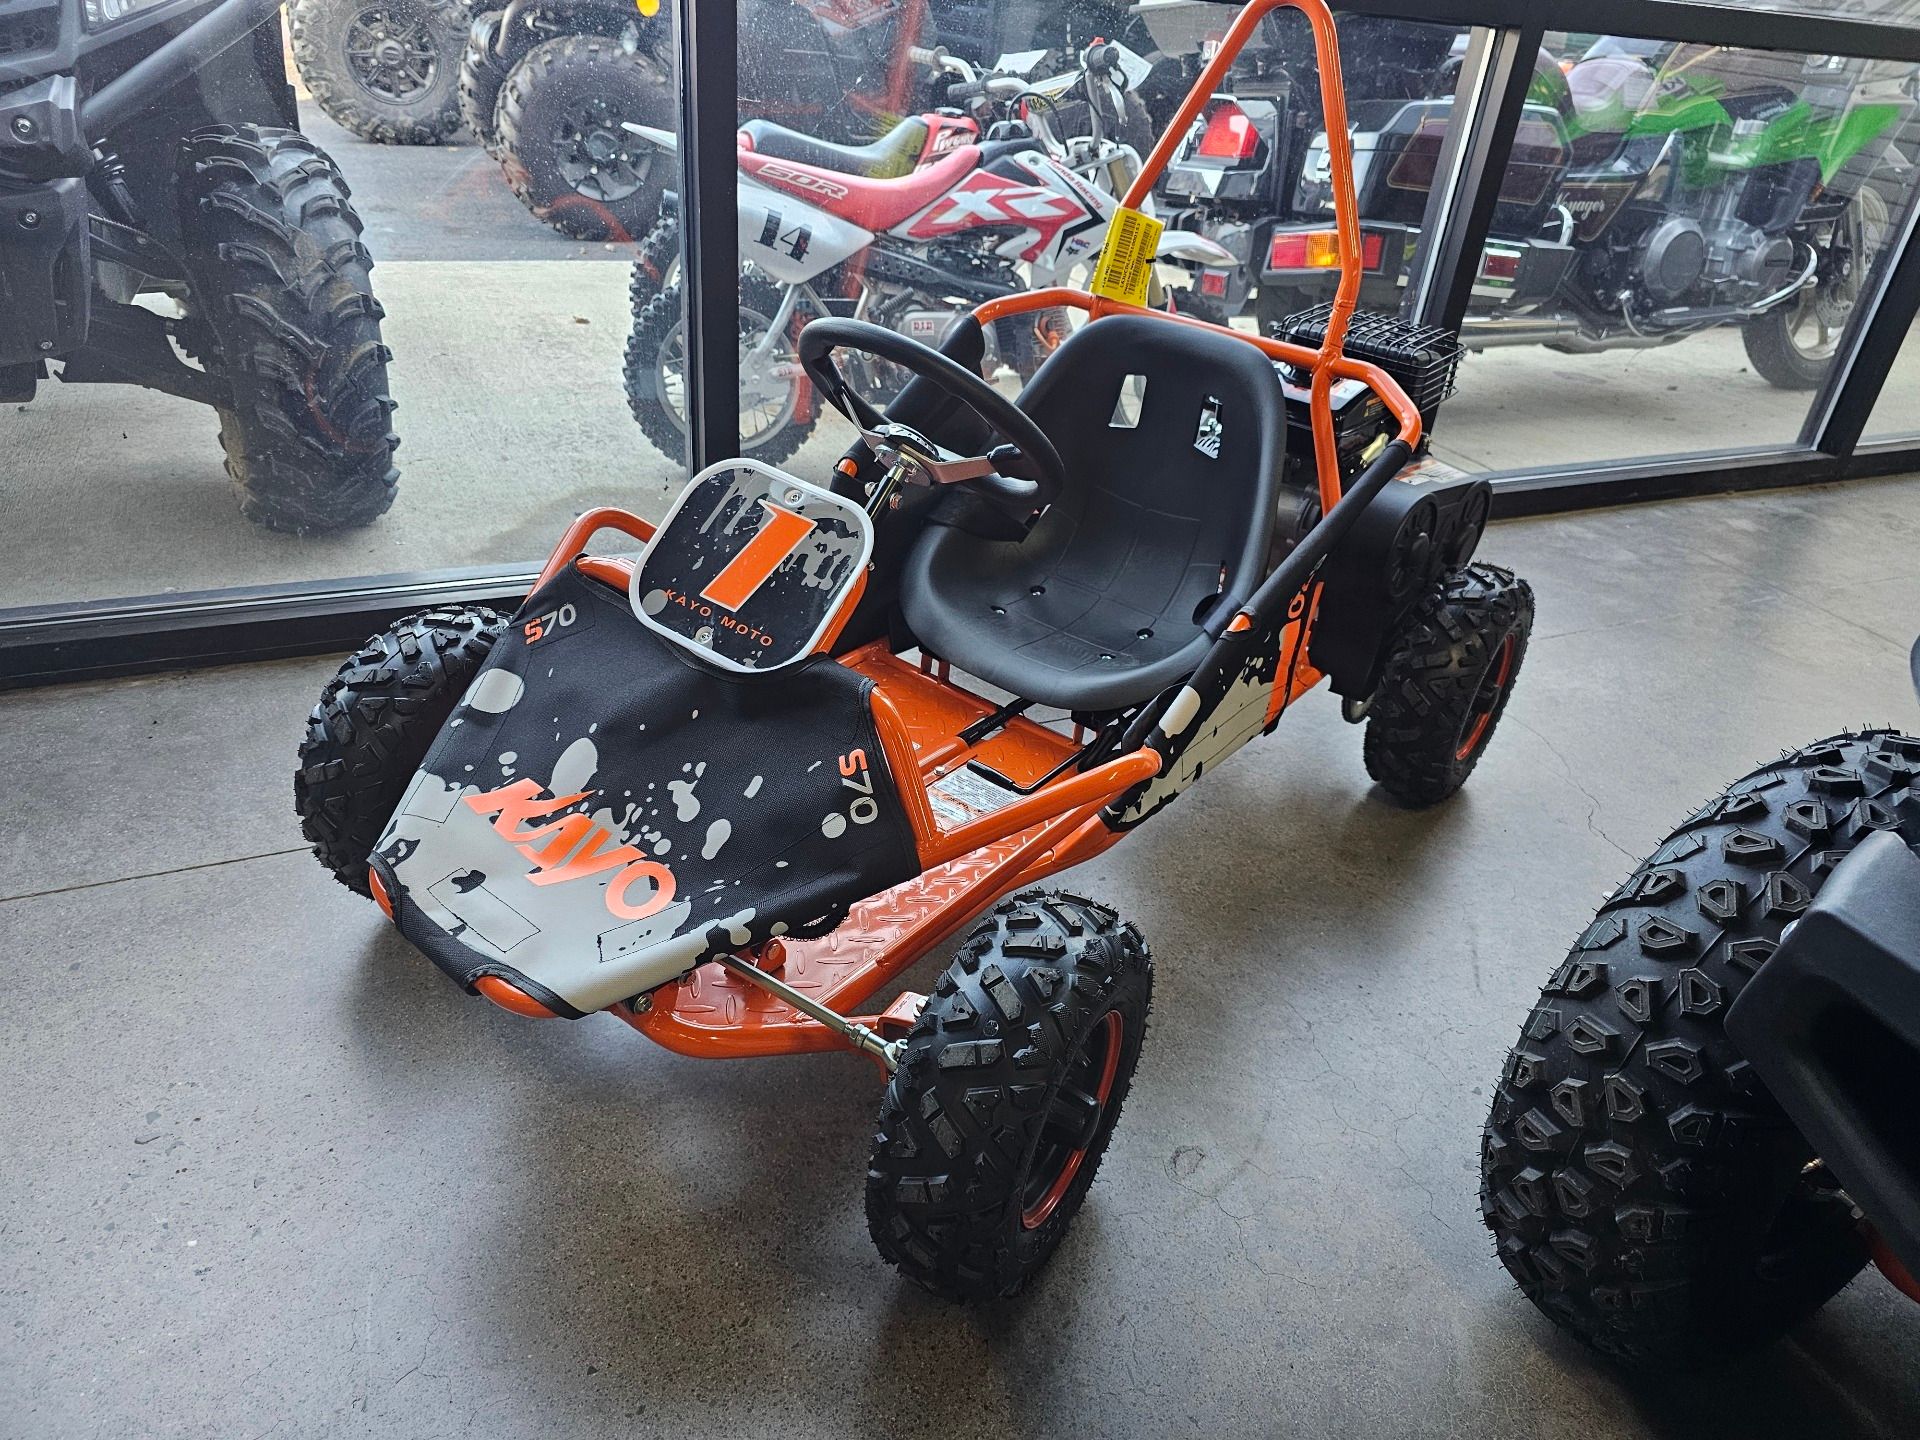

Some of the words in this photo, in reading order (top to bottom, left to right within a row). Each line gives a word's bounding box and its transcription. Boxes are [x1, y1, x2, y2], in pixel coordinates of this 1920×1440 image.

[757, 162, 848, 200] 50R
[1074, 180, 1104, 210] Racing
[753, 206, 813, 262] 14
[699, 499, 818, 612] 1
[524, 603, 577, 645] S70
[665, 589, 713, 617] KAYO
[720, 615, 774, 648] MOTO
[838, 748, 879, 825] S70
[462, 777, 677, 920] KAYO
